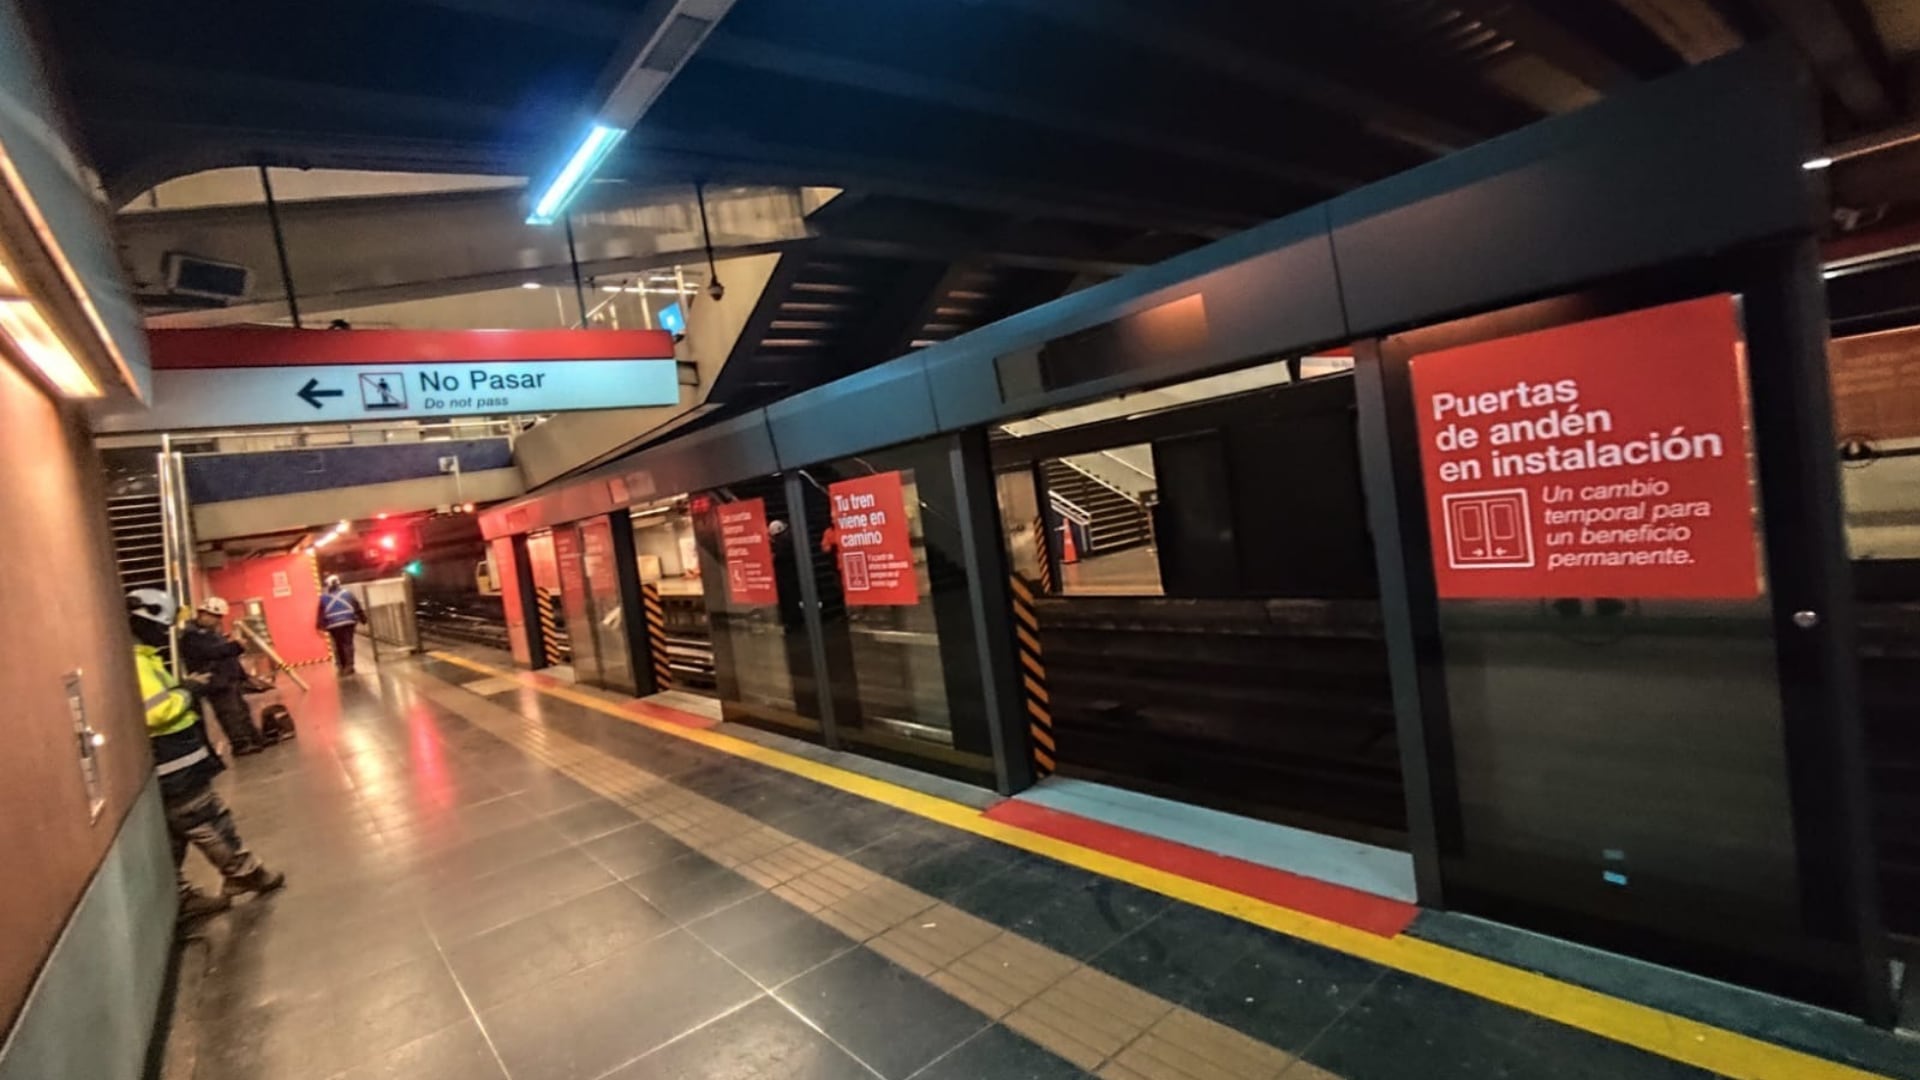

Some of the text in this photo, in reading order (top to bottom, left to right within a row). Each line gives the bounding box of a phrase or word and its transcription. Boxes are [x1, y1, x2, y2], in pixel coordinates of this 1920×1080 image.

[419, 370, 546, 392] No Pasar
[424, 396, 509, 409] Do not pass
[1431, 379, 1579, 421] Puertas
[1435, 404, 1612, 451] de andén
[1439, 427, 1723, 482] en instalación
[1542, 478, 1670, 503] Un cambio
[834, 494, 875, 511] Tu tren
[1544, 500, 1711, 525] temporal para
[838, 511, 886, 529] viene en
[841, 528, 883, 548] camino
[1546, 523, 1691, 546] un beneficio
[1548, 548, 1696, 571] permanente.
